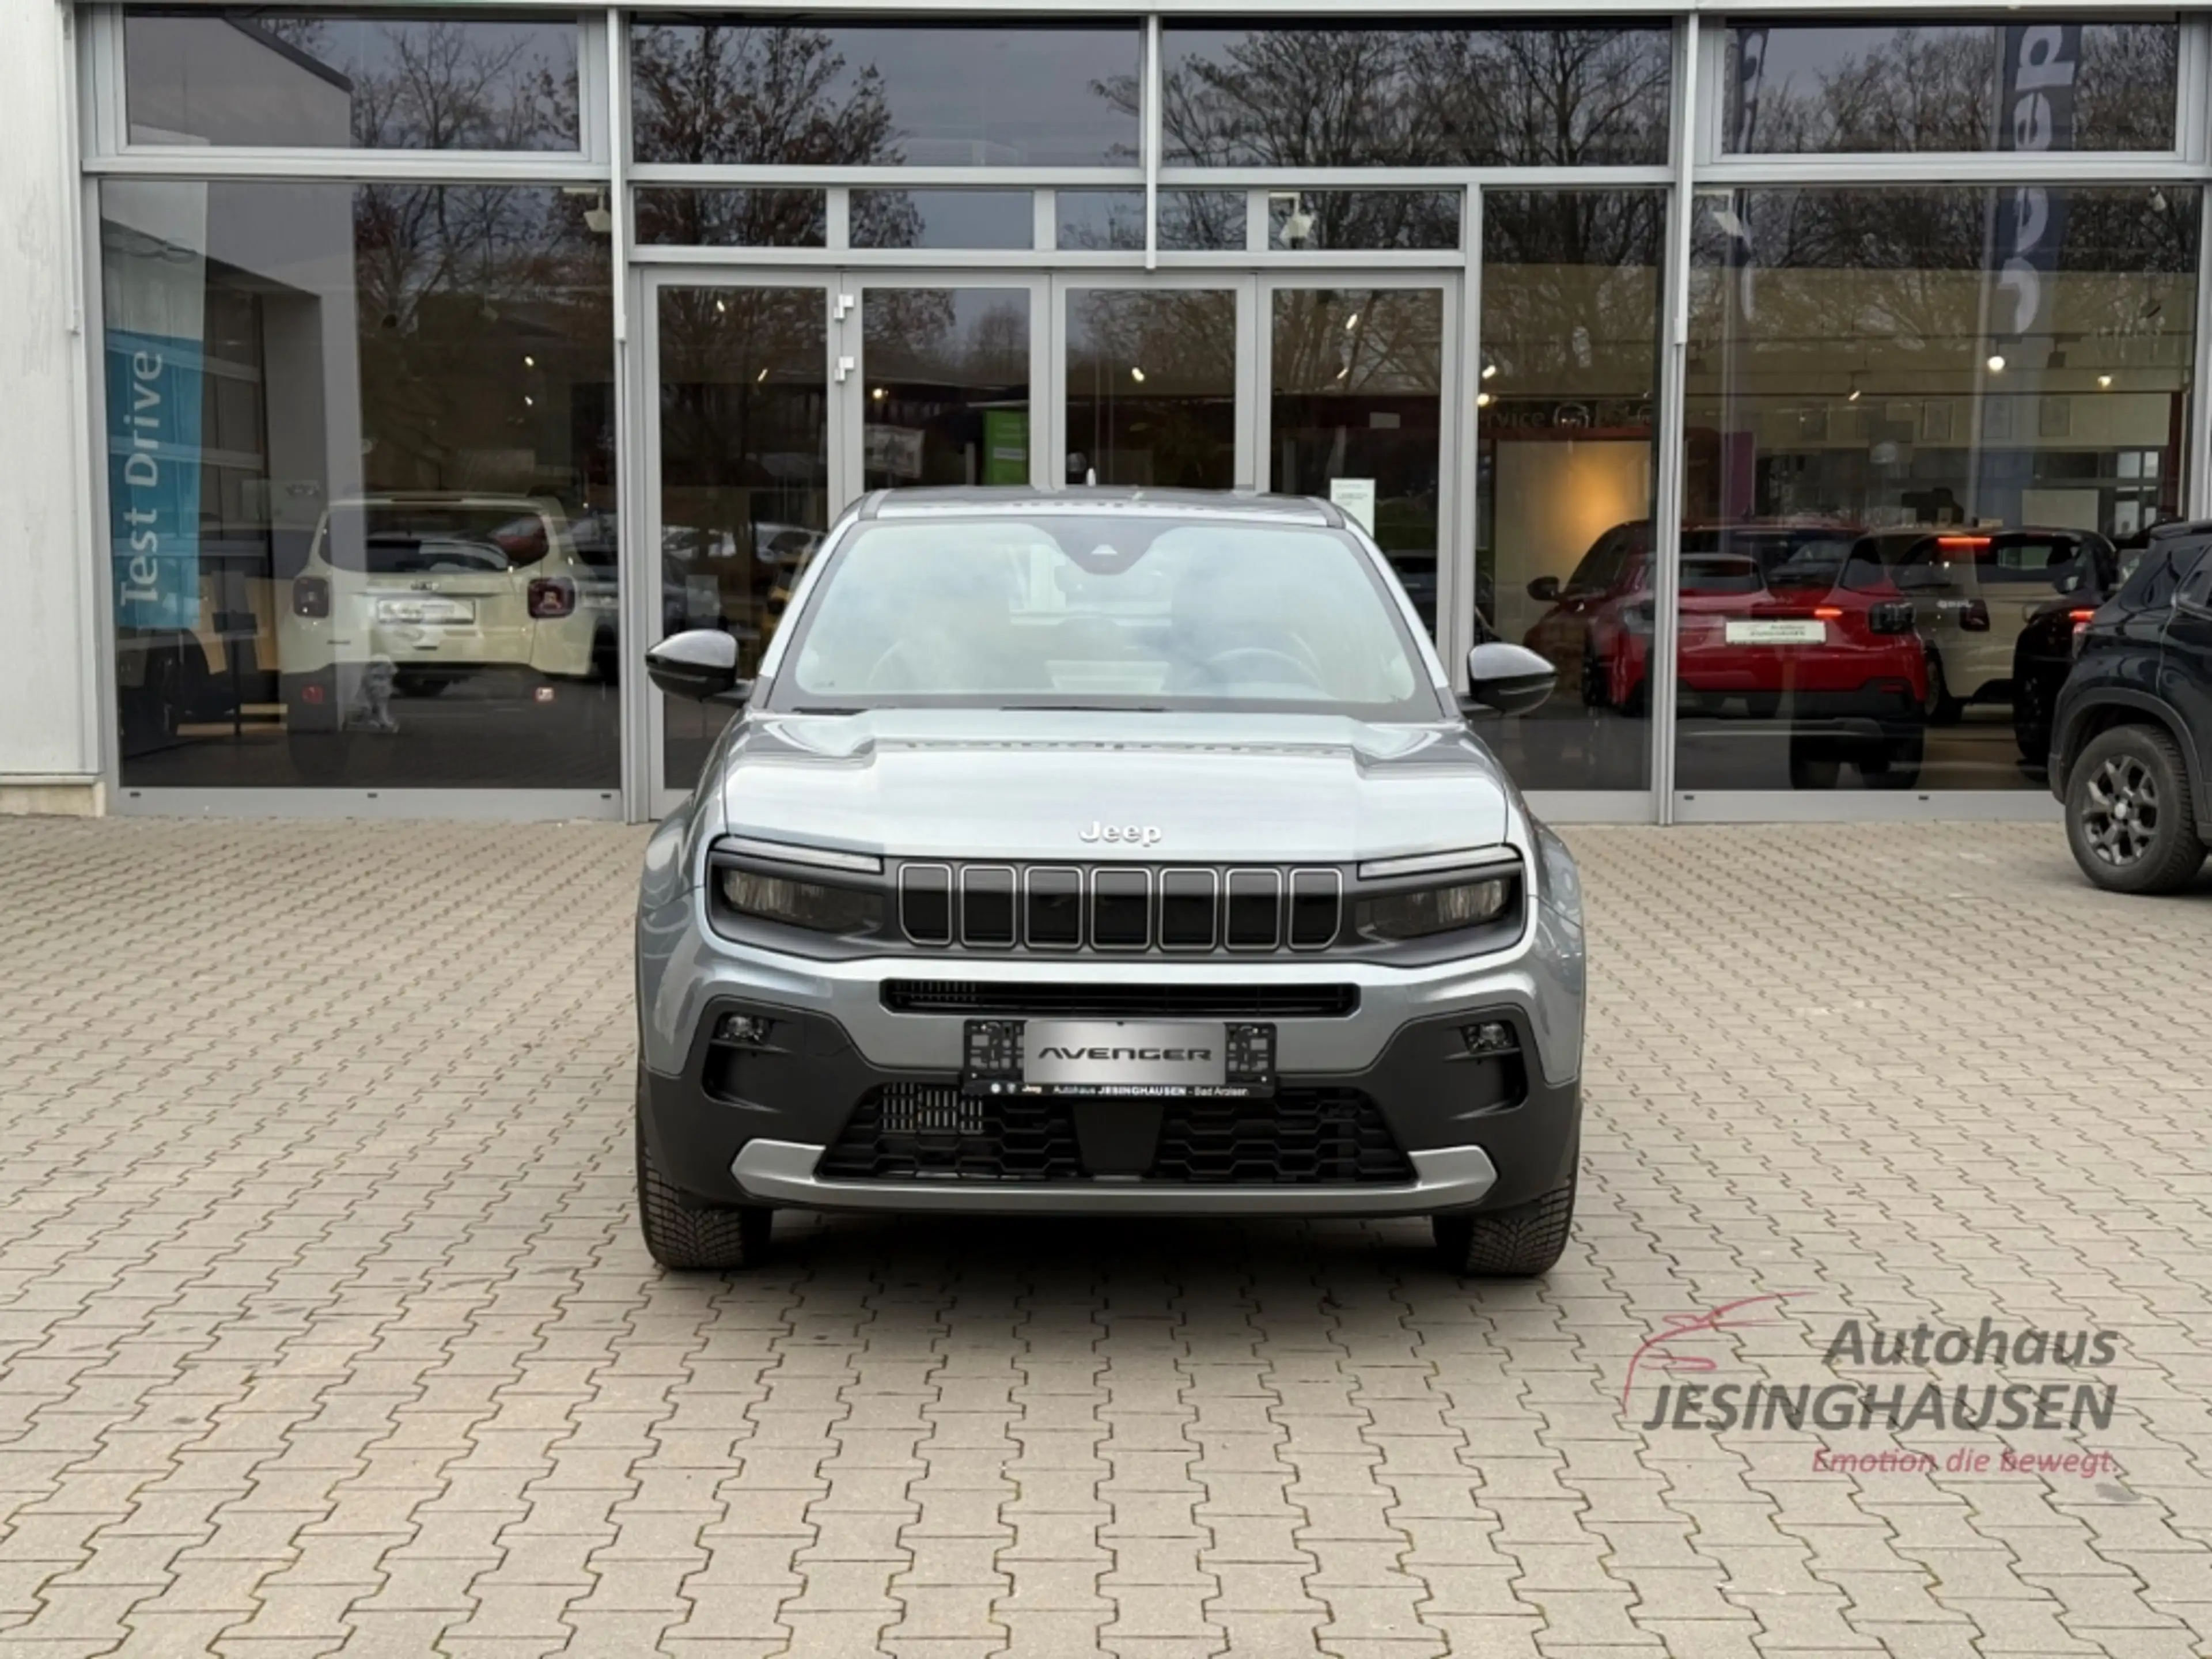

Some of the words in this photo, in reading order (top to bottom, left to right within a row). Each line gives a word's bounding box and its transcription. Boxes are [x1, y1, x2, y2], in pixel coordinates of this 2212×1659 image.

[123, 350, 162, 487] Drive
[120, 507, 159, 607] Test
[1080, 820, 1162, 848] Jeep
[1038, 1047, 1213, 1061] AVENGER
[1053, 1085, 1096, 1094] Autohaus
[1097, 1086, 1187, 1095] JESINGHAUSEN
